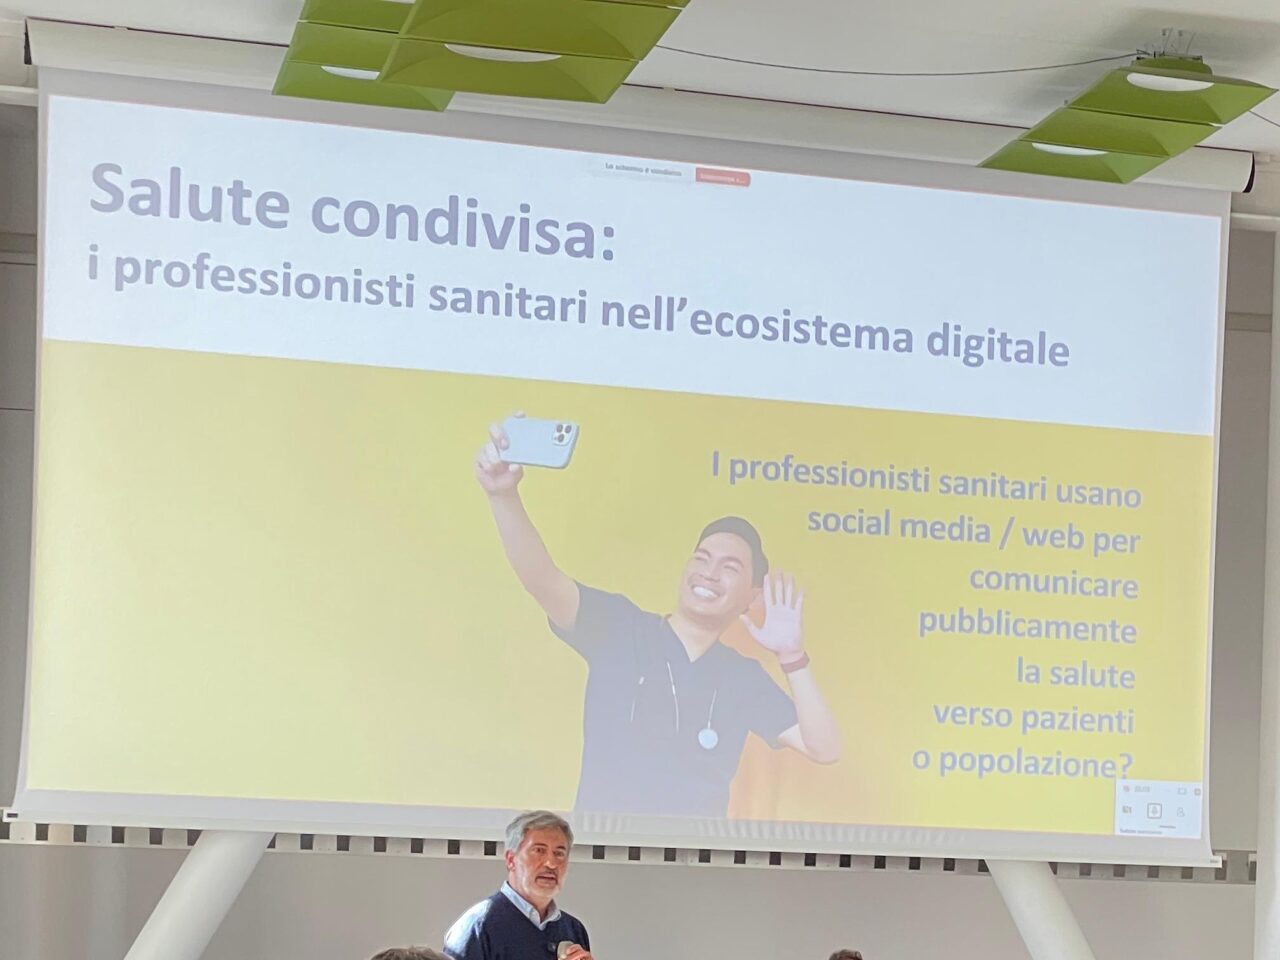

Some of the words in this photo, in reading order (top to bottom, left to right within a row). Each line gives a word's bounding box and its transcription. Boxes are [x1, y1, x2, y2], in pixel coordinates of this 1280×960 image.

[90, 162, 290, 229] Salute
[311, 194, 615, 261] condivisa:
[88, 243, 99, 280] i
[115, 252, 415, 309] professionisti
[428, 282, 588, 324] sanitari
[601, 295, 913, 353] nell’ecosistema
[926, 321, 1070, 368] digitale
[712, 450, 720, 477] I
[729, 454, 931, 494] professionisti
[938, 471, 1047, 502] sanitari
[1056, 484, 1142, 509] usano
[807, 509, 890, 536] social
[900, 517, 992, 543] media
[999, 516, 1015, 550] /
[1022, 520, 1085, 549] web
[1093, 530, 1140, 557] per
[969, 566, 1139, 600] comunicare
[919, 607, 1138, 644] pubblicamente
[1017, 656, 1041, 684] la
[1050, 659, 1136, 689] salute
[933, 703, 1013, 728] verso
[1021, 706, 1135, 736] pazienti
[912, 749, 931, 771] o
[939, 748, 1134, 780] popolazione?
